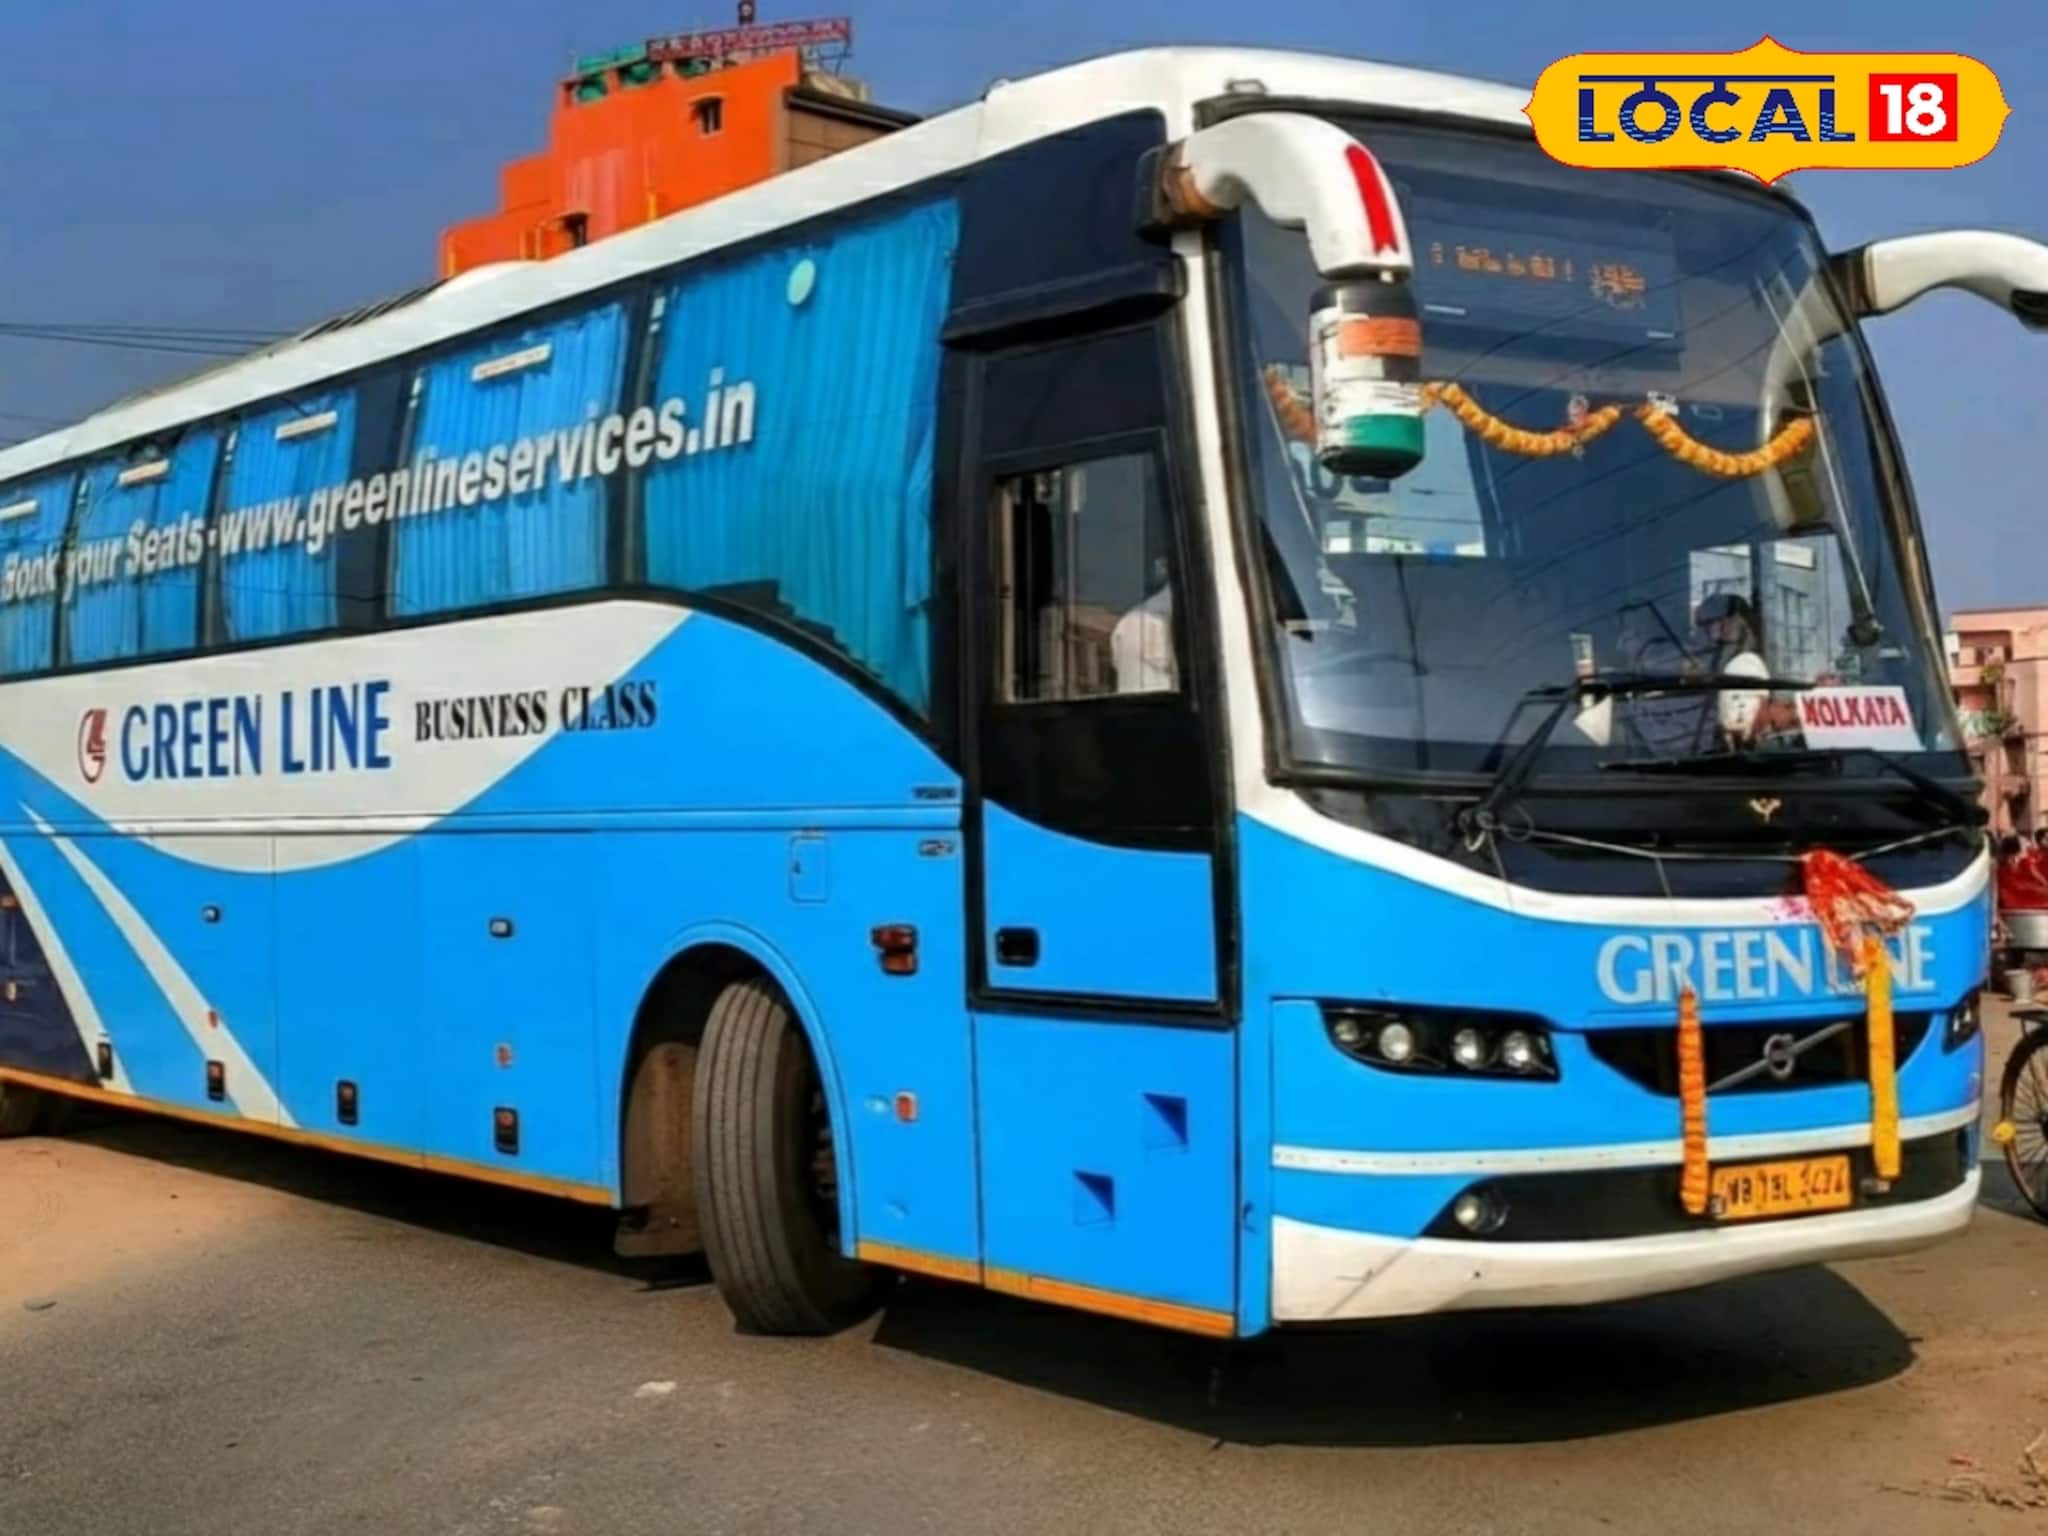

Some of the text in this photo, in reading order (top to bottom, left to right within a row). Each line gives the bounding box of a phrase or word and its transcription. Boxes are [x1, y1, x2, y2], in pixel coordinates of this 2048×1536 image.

[121, 679, 391, 782] GREEN LINE
[414, 680, 658, 742] BUSINESS CLASS
[1801, 695, 1906, 727] KOLKATA
[1597, 925, 1936, 1005] GREEN LNE
